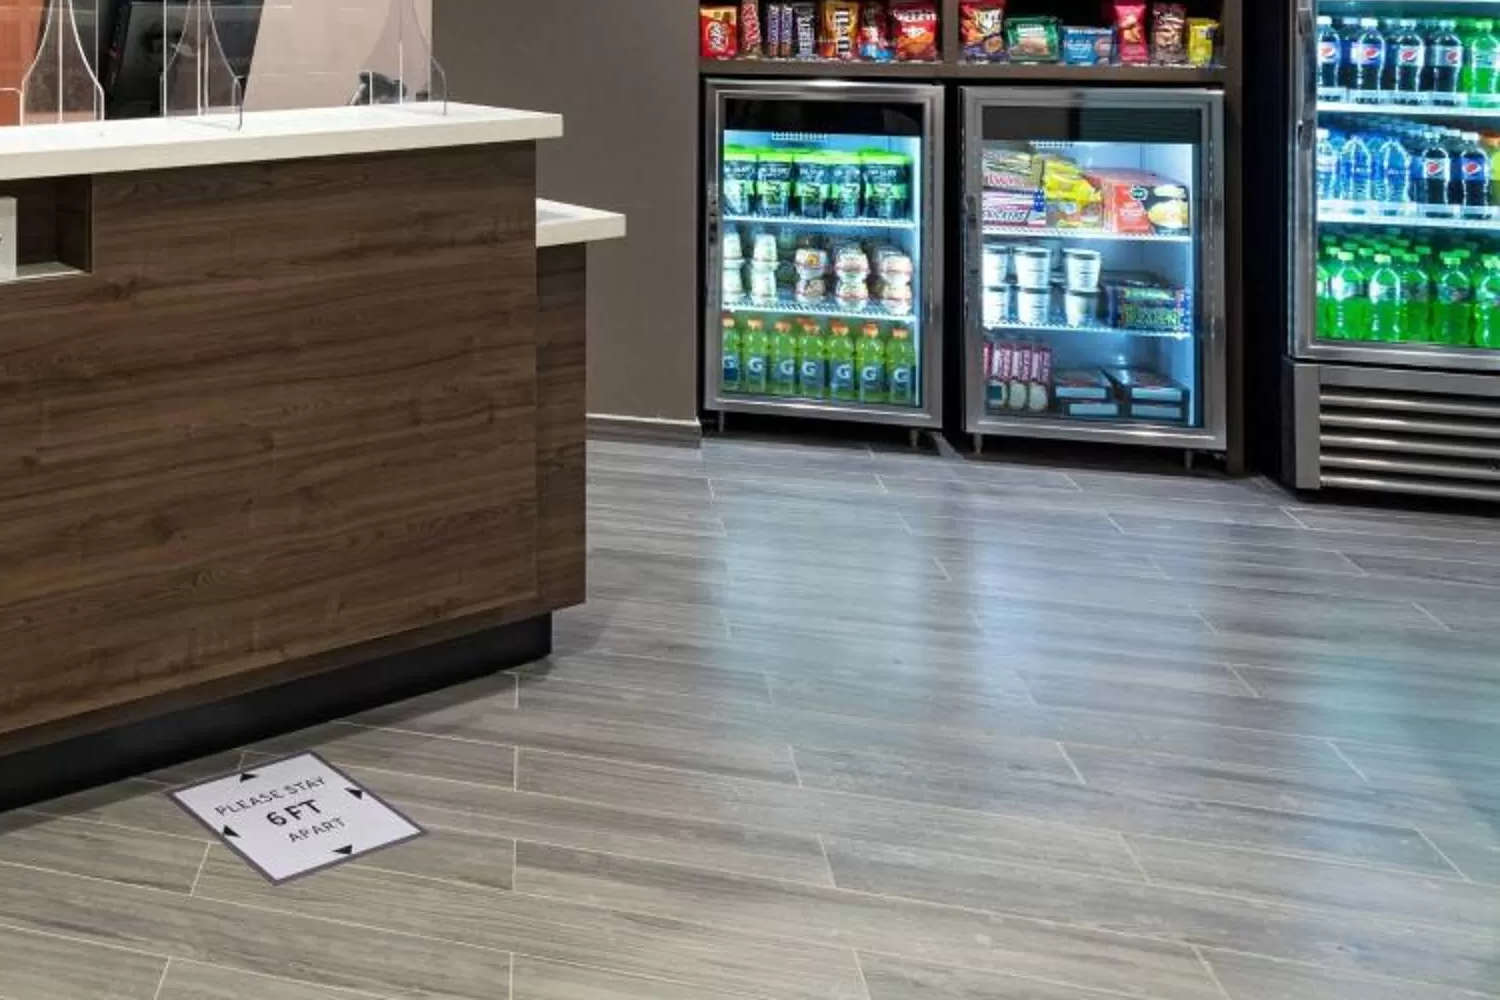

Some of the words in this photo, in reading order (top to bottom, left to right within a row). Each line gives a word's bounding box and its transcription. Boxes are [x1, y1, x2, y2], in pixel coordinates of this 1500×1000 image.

[214, 790, 284, 816] PLEASE
[285, 776, 325, 797] STAY
[266, 811, 287, 826] 6
[284, 799, 321, 820] FT
[288, 817, 346, 842] APART
